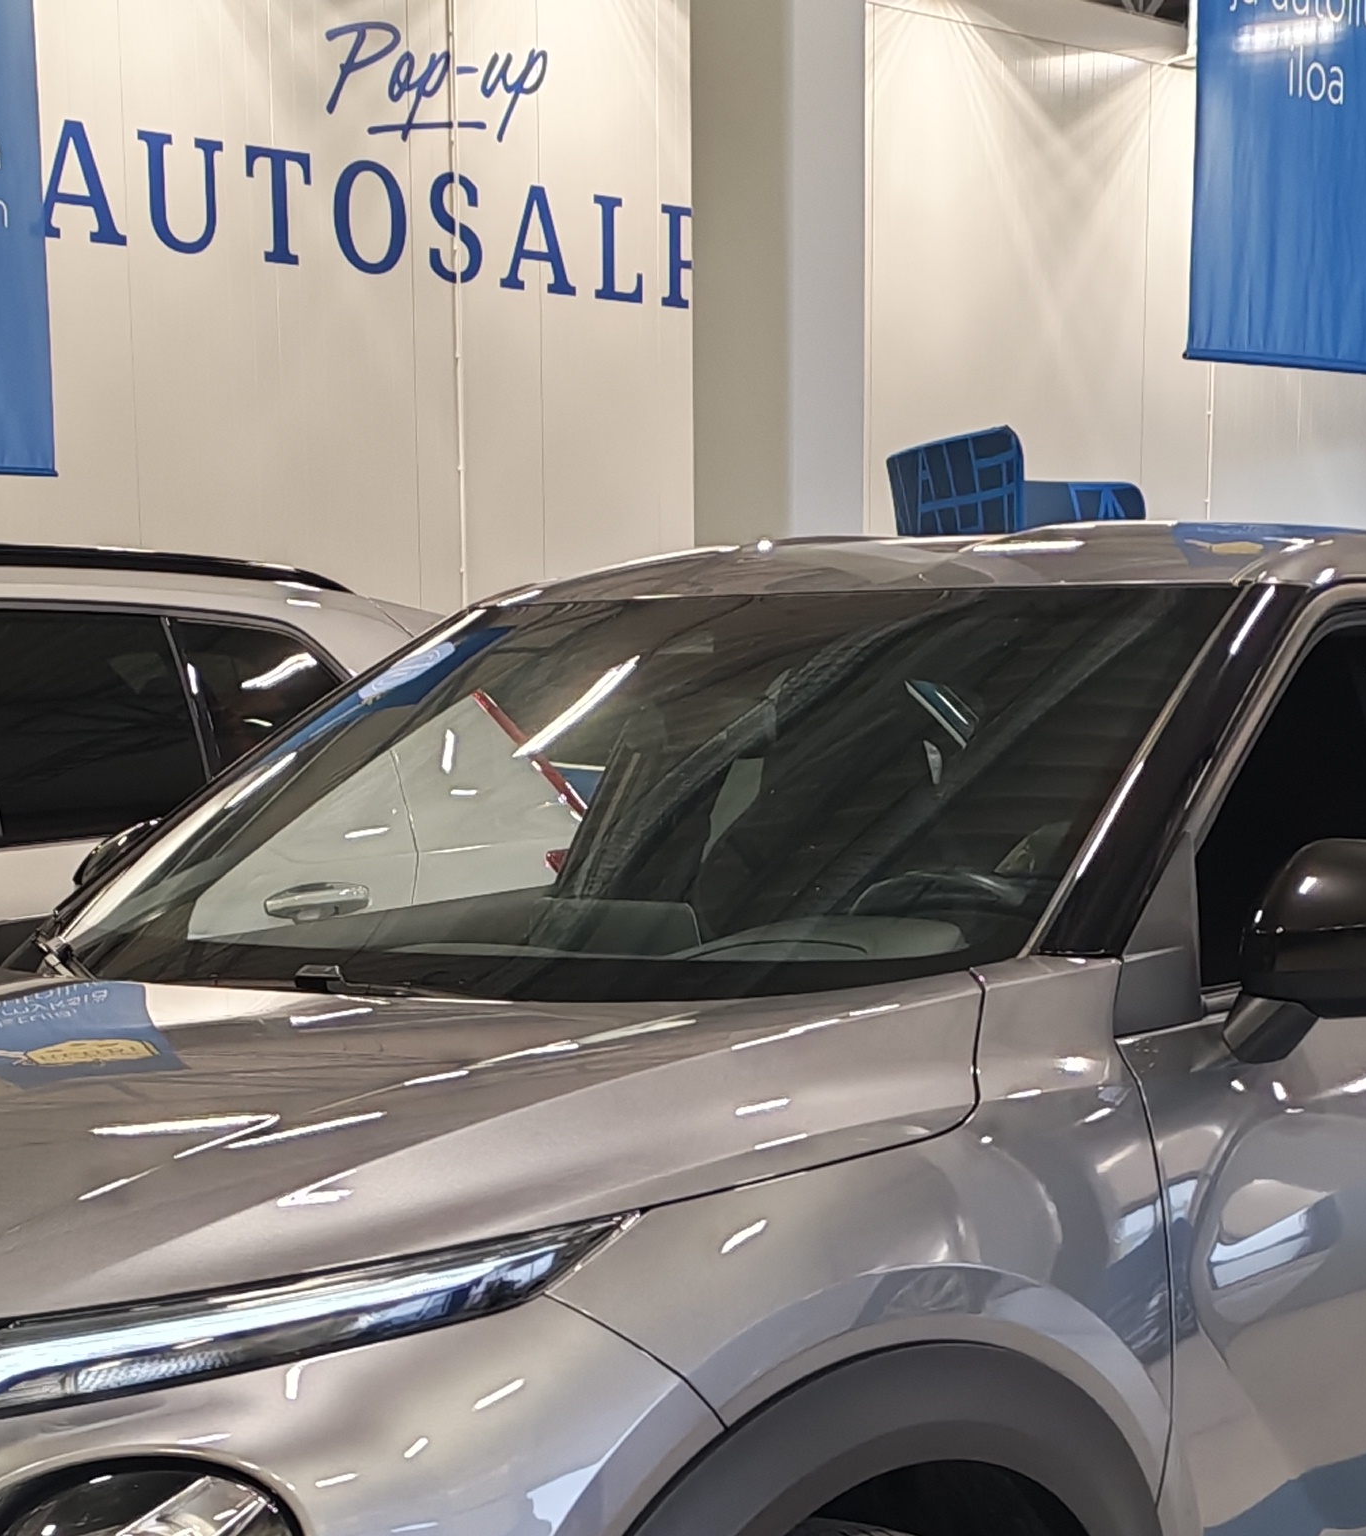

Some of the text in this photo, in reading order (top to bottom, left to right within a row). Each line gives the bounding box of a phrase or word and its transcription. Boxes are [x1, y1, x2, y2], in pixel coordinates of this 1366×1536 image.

[325, 21, 548, 142] Pop-up
[1289, 44, 1344, 105] iloa
[43, 119, 693, 309] AUTOSALP
